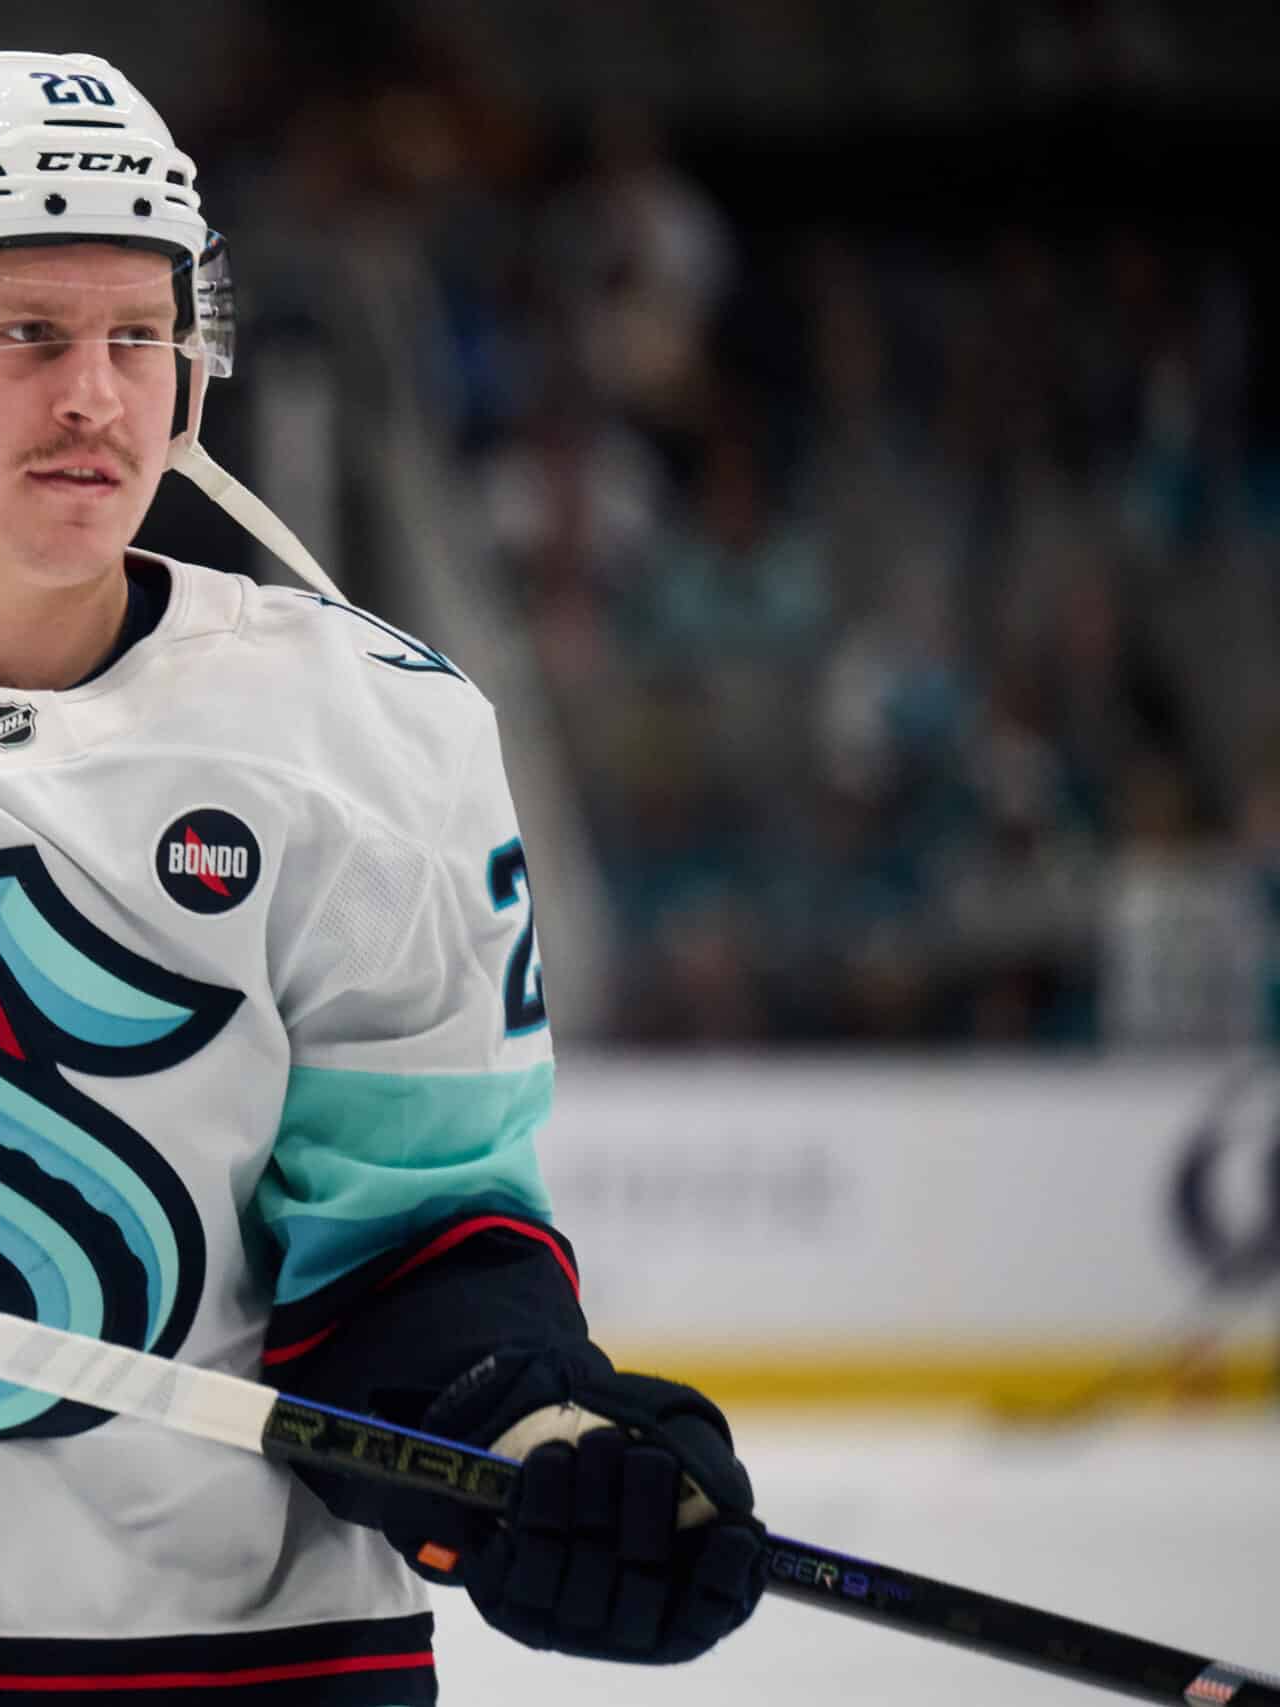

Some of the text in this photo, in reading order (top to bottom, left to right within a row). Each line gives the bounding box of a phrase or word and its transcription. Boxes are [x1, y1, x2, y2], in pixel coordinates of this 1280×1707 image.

[28, 72, 115, 106] 20
[36, 152, 153, 175] CCM
[168, 842, 248, 878] BONDO
